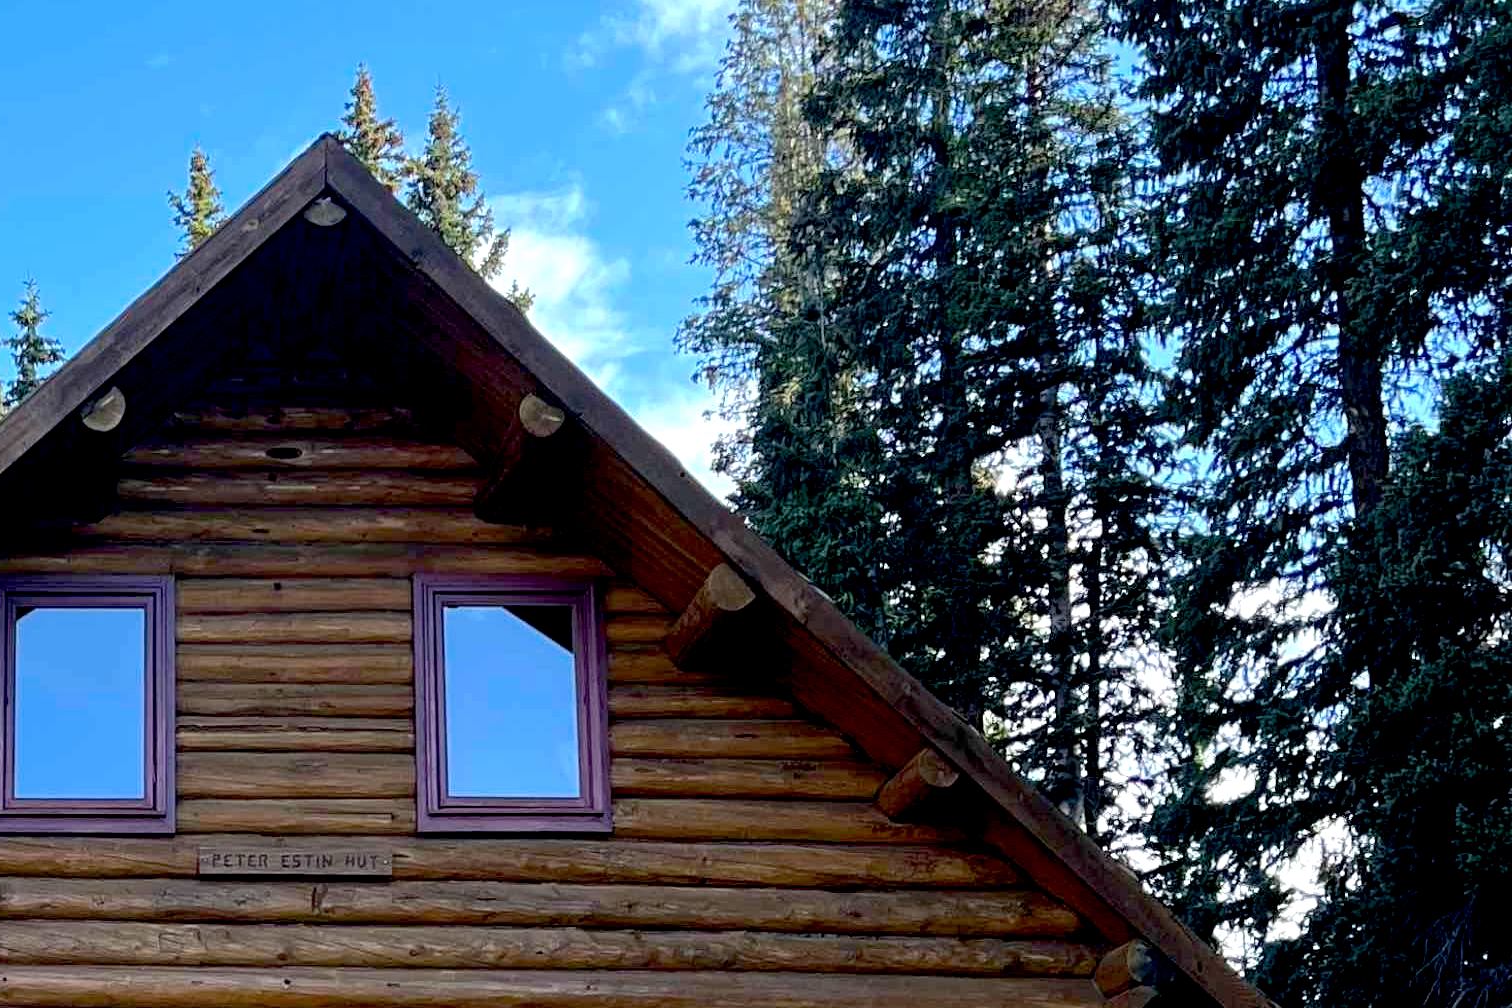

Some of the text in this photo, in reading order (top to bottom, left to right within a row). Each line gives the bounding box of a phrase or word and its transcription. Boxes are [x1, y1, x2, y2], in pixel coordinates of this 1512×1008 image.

[212, 853, 378, 869] PETER ESTIN HUT
